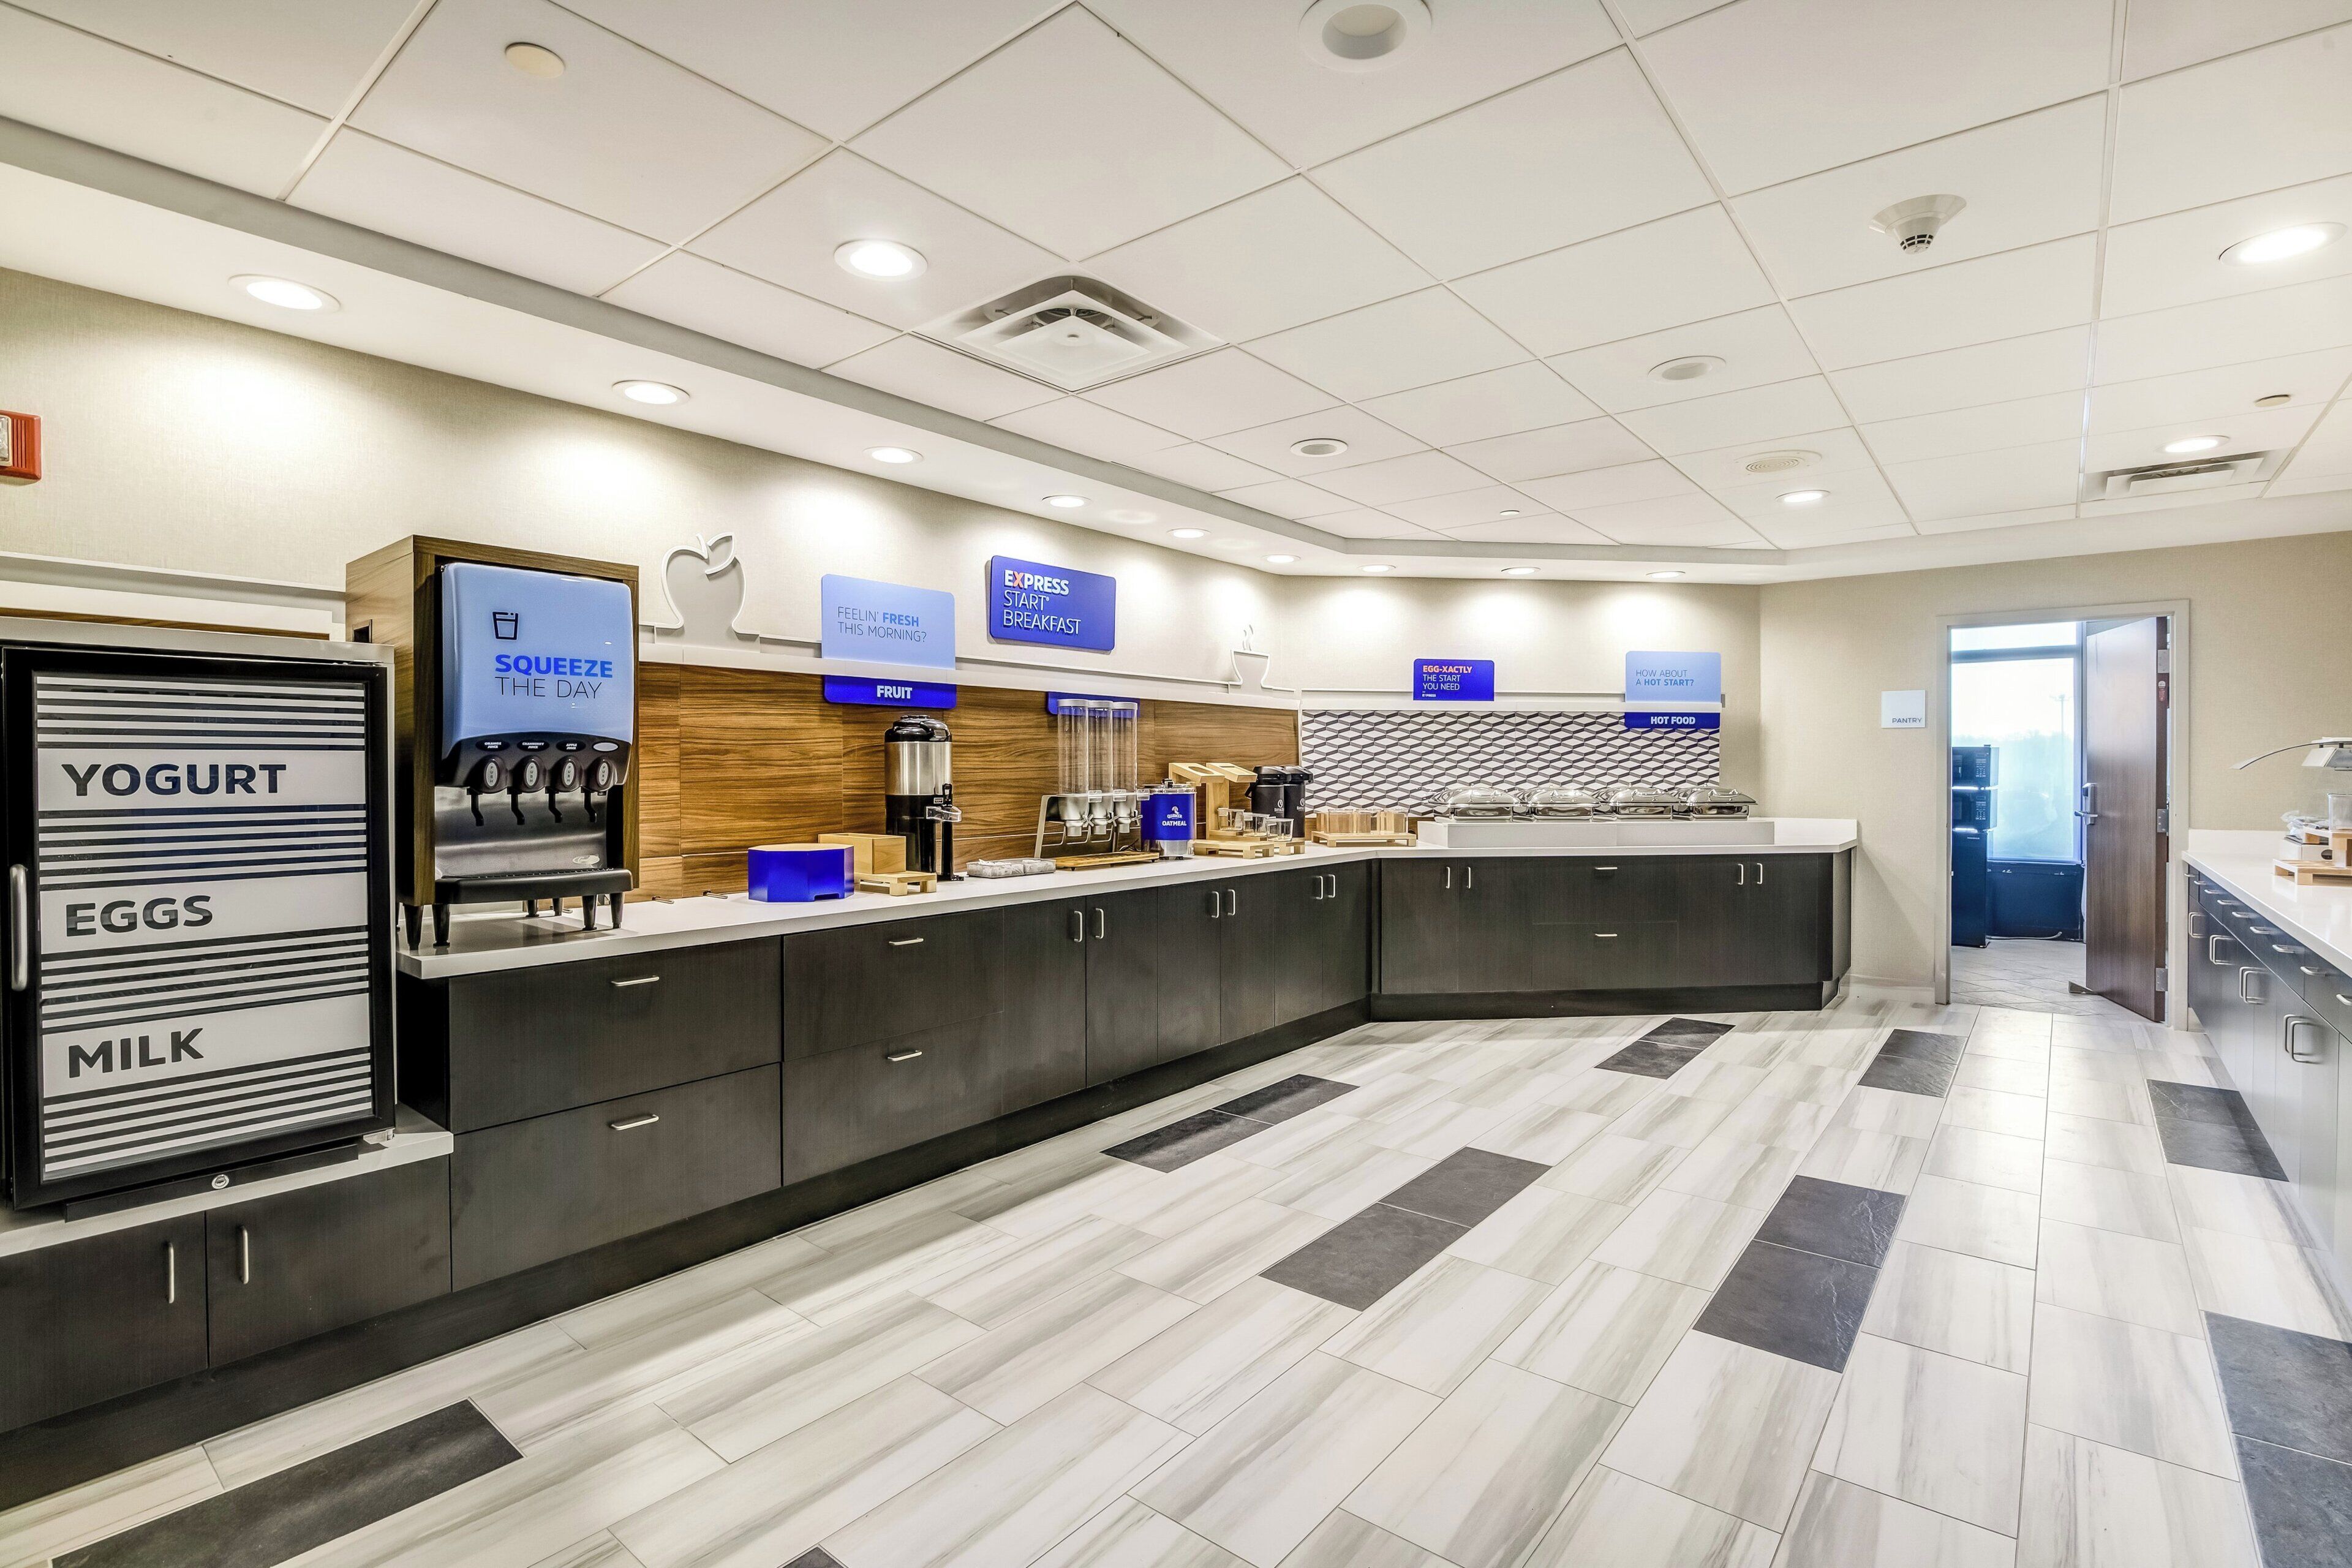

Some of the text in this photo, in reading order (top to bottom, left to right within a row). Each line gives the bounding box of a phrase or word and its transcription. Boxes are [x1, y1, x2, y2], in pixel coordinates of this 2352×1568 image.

[1005, 569, 1069, 595] EXPRESS
[883, 612, 919, 627] FRESH
[1003, 609, 1082, 635] BREAKFAST
[837, 621, 927, 643] THIS MORNING?
[495, 654, 612, 678] SQUEEZE
[495, 676, 602, 699] THE DAY
[876, 685, 913, 699] FRUIT
[1651, 716, 1696, 725] HOT FOOD
[61, 763, 287, 796] YOGURT
[66, 895, 213, 937] EGGS
[69, 1028, 204, 1078] MILK
